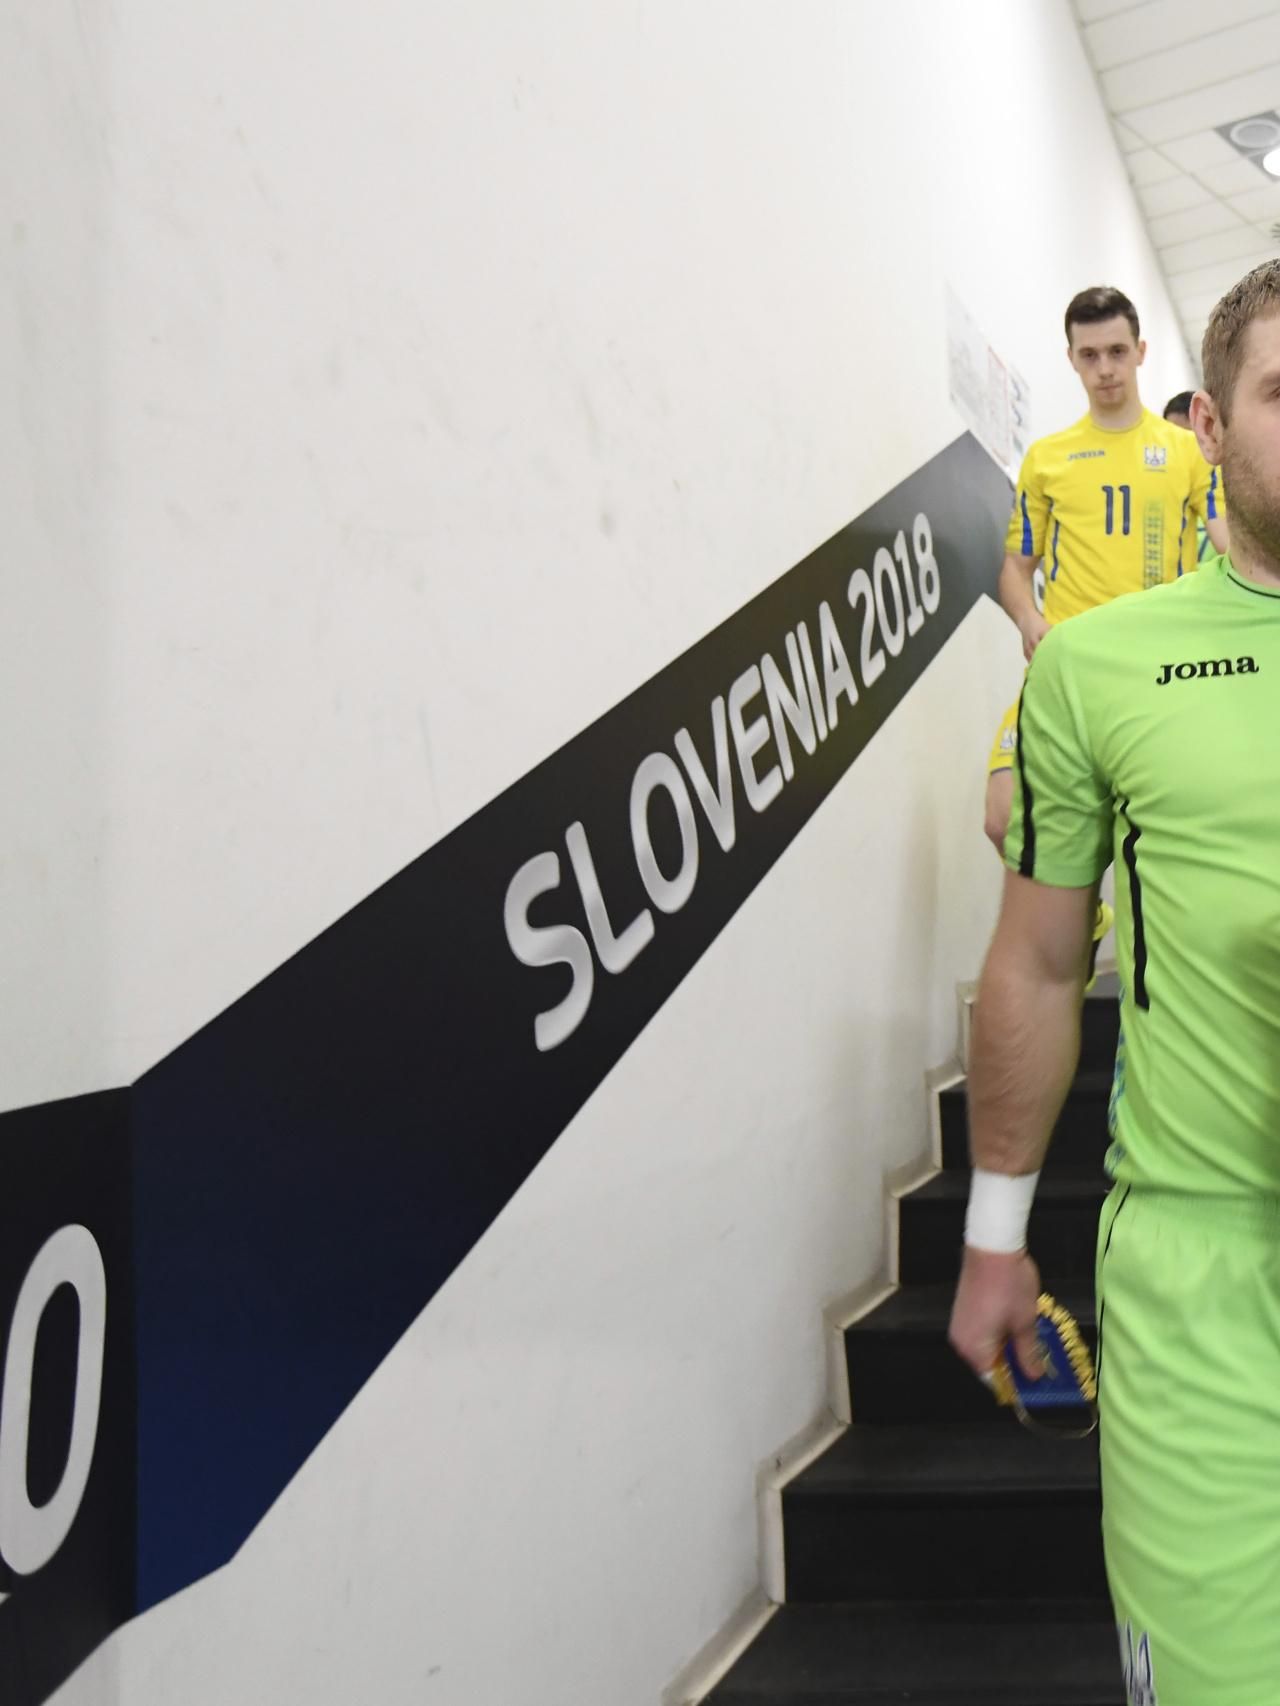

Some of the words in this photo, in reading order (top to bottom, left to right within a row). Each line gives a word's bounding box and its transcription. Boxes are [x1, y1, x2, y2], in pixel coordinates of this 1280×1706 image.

[1101, 485, 1131, 536] 11
[503, 601, 858, 1051] SLOVENIA
[846, 511, 941, 687] 2018
